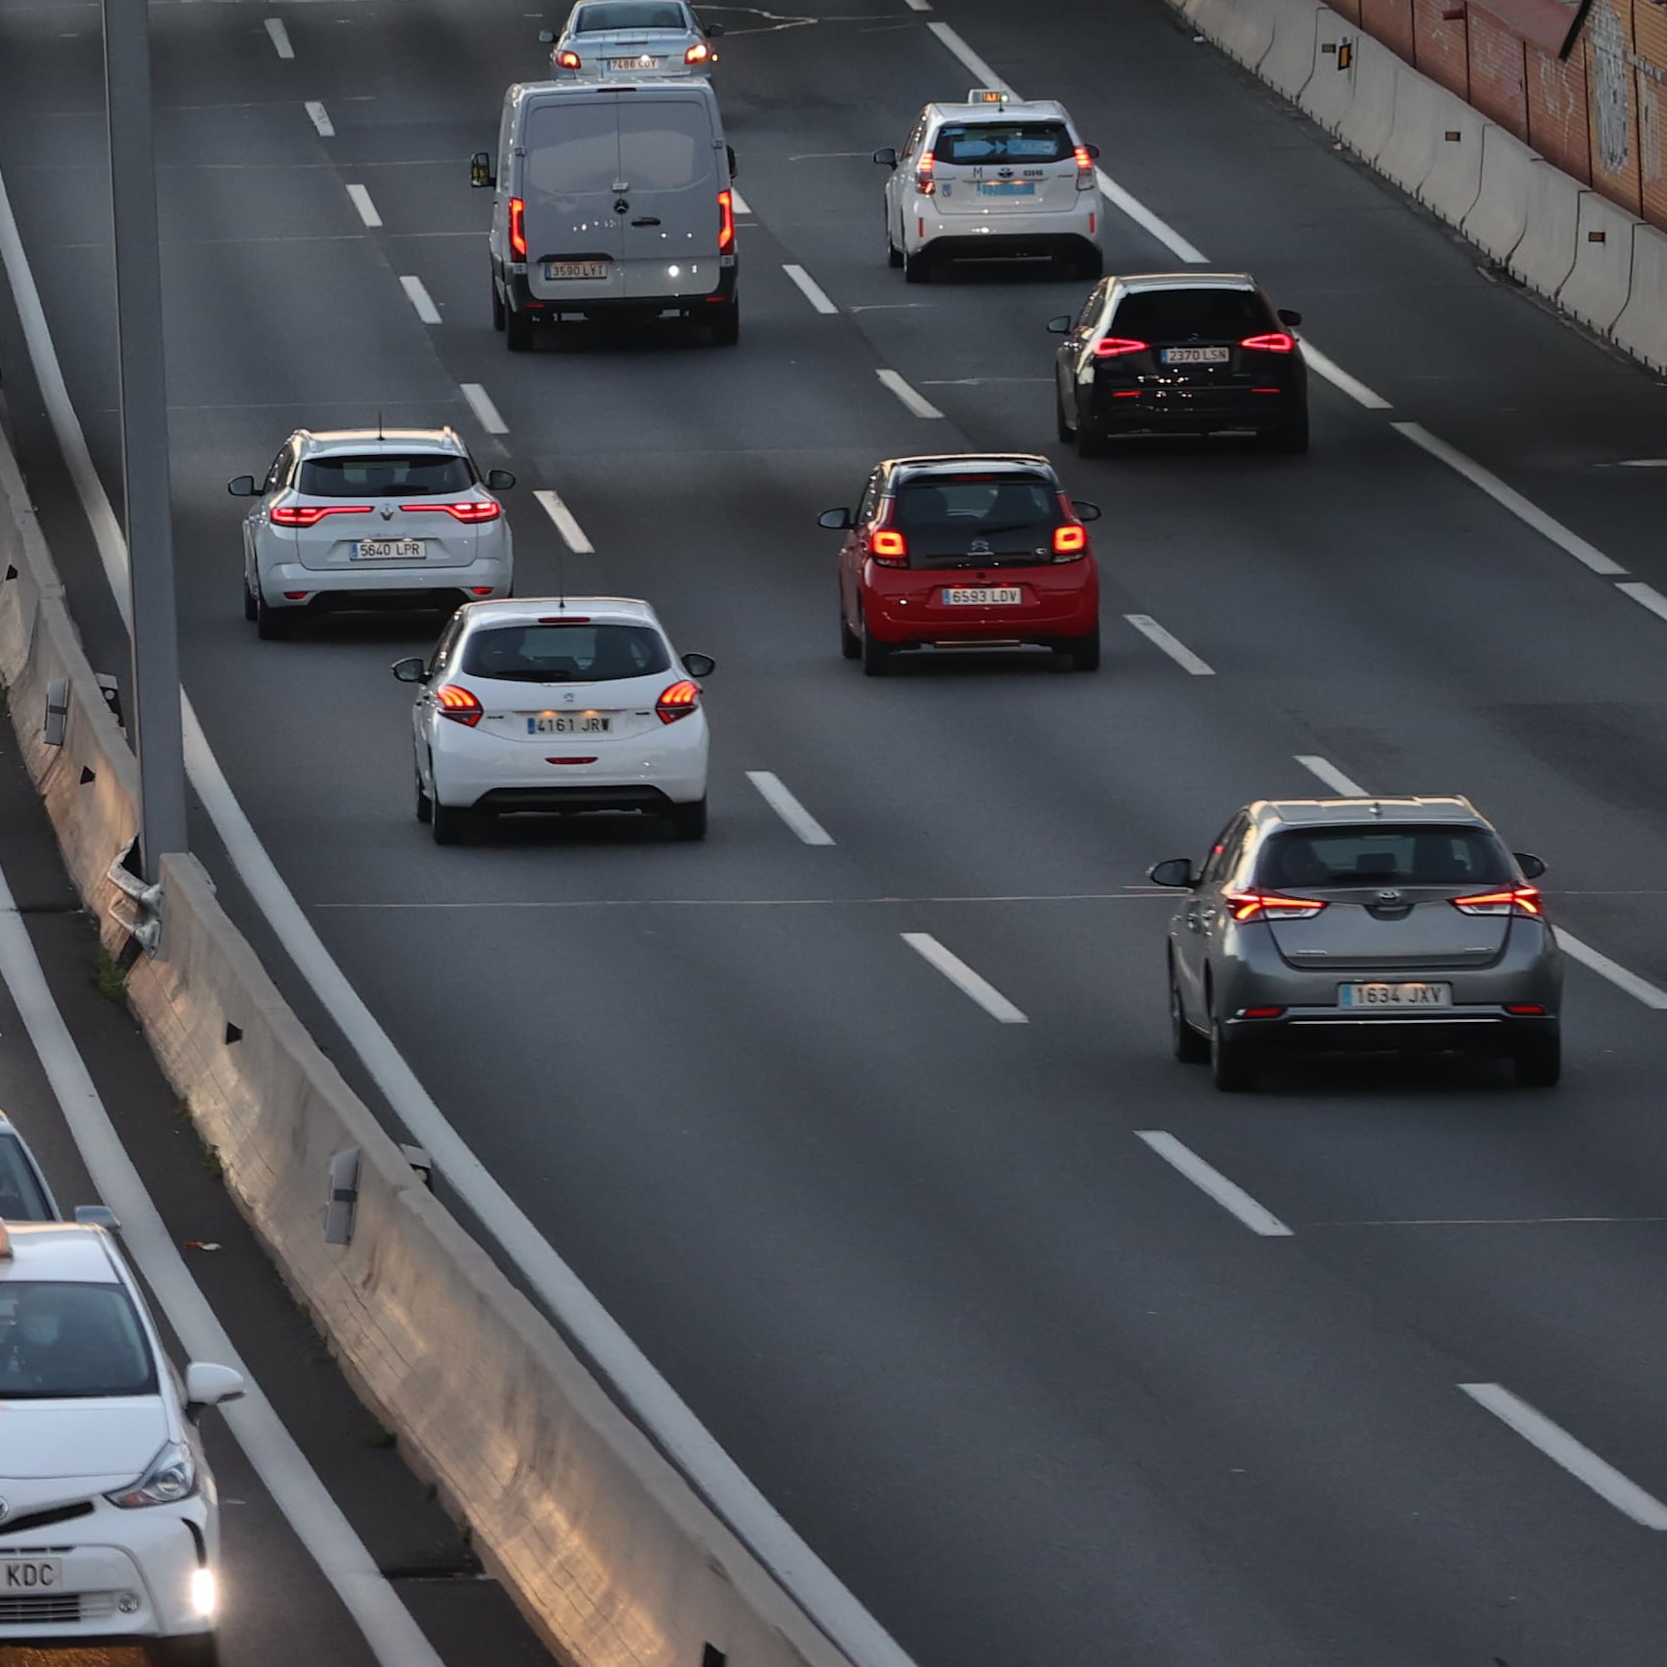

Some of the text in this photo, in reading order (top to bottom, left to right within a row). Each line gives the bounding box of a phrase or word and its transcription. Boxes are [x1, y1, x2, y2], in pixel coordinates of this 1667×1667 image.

[553, 266, 580, 277] 3590
[1169, 349, 1227, 362] 2370 LSN
[359, 543, 420, 557] 5640 LPR
[952, 589, 1017, 603] 6593 LDV
[538, 718, 610, 733] 4161 JRW
[1357, 987, 1442, 1004] 1634 JXV
[6, 1564, 54, 1586] KDC
